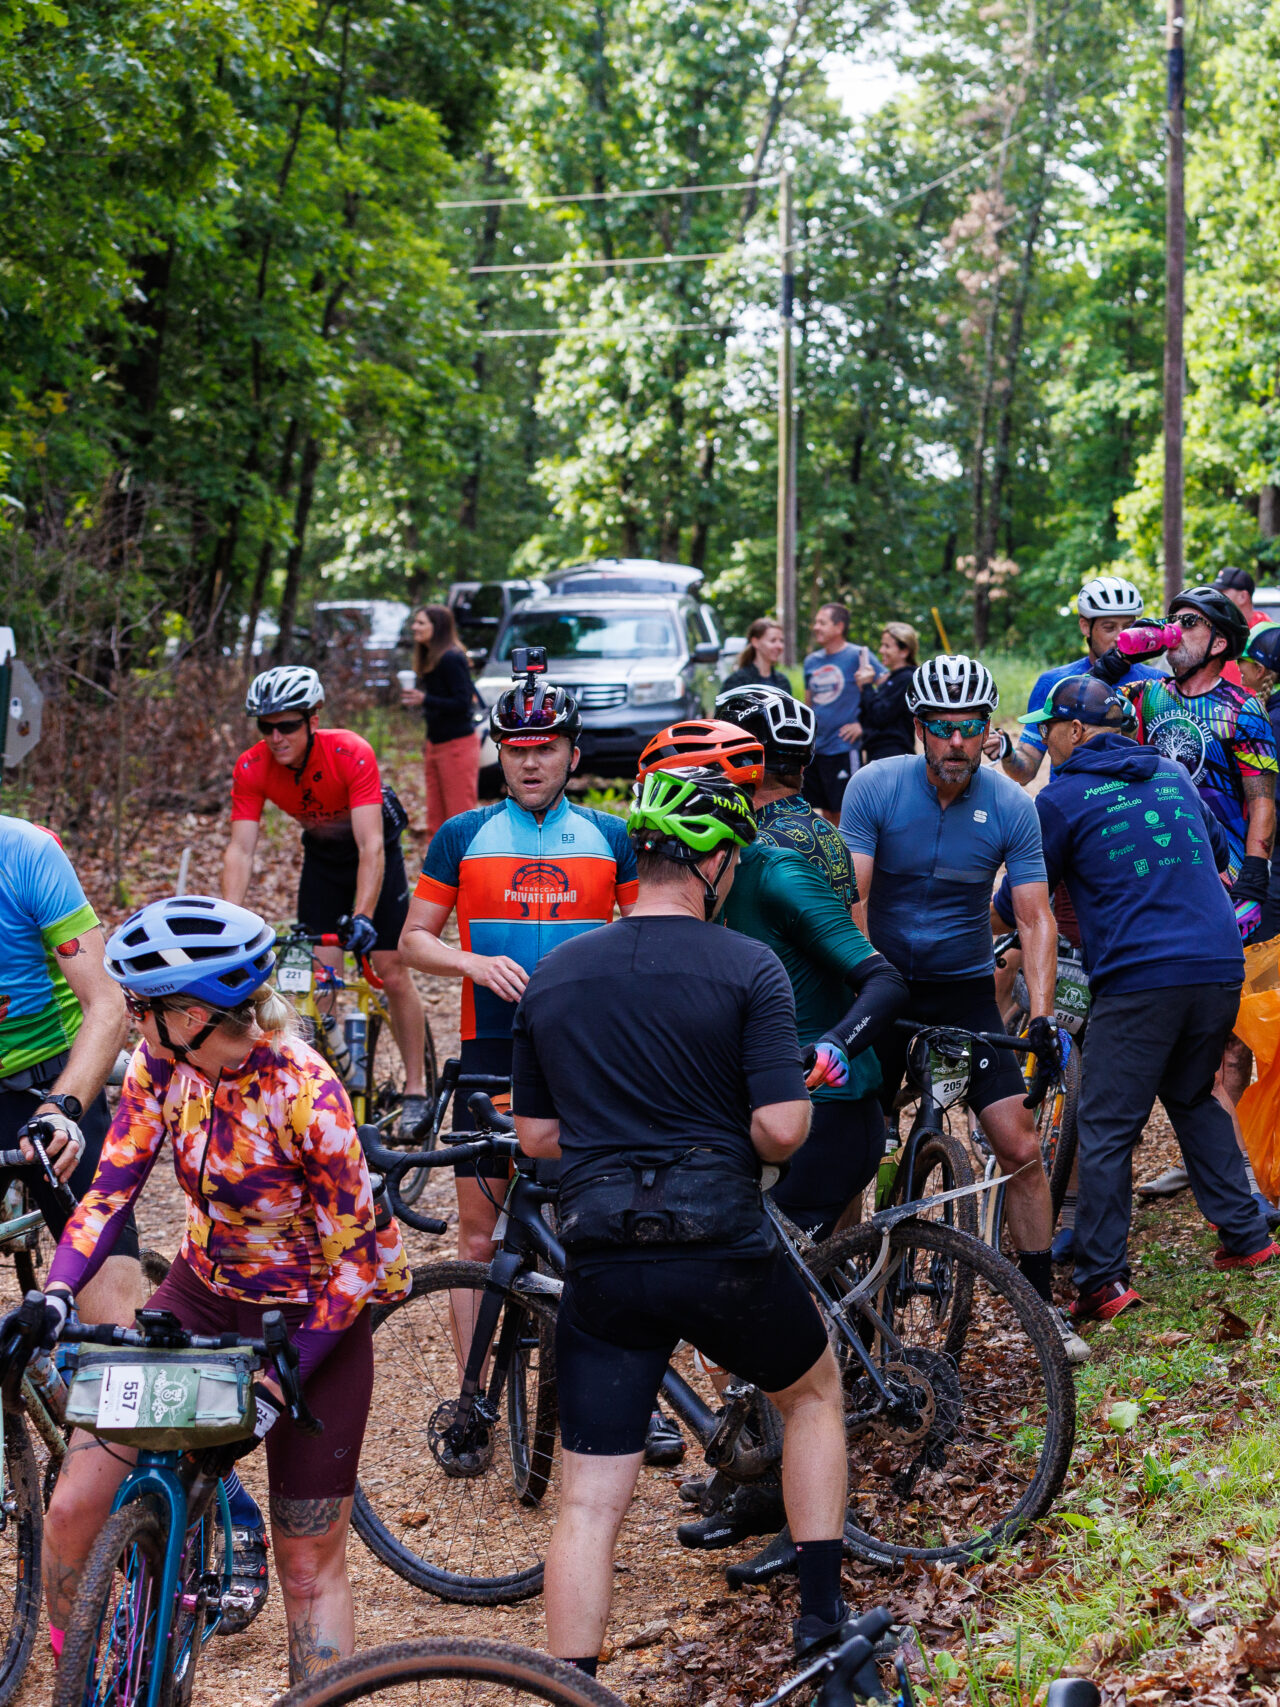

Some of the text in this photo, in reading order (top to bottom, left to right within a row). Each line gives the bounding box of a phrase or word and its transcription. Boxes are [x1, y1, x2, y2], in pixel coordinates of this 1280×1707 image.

[738, 705, 759, 721] POC
[1145, 709, 1214, 743] MULREADY'S PUB
[504, 889, 577, 904] PRIVATE IDAHO
[285, 970, 301, 979] 221
[1056, 1012, 1075, 1024] 519
[943, 1080, 961, 1093] 205
[122, 1380, 139, 1411] 557
